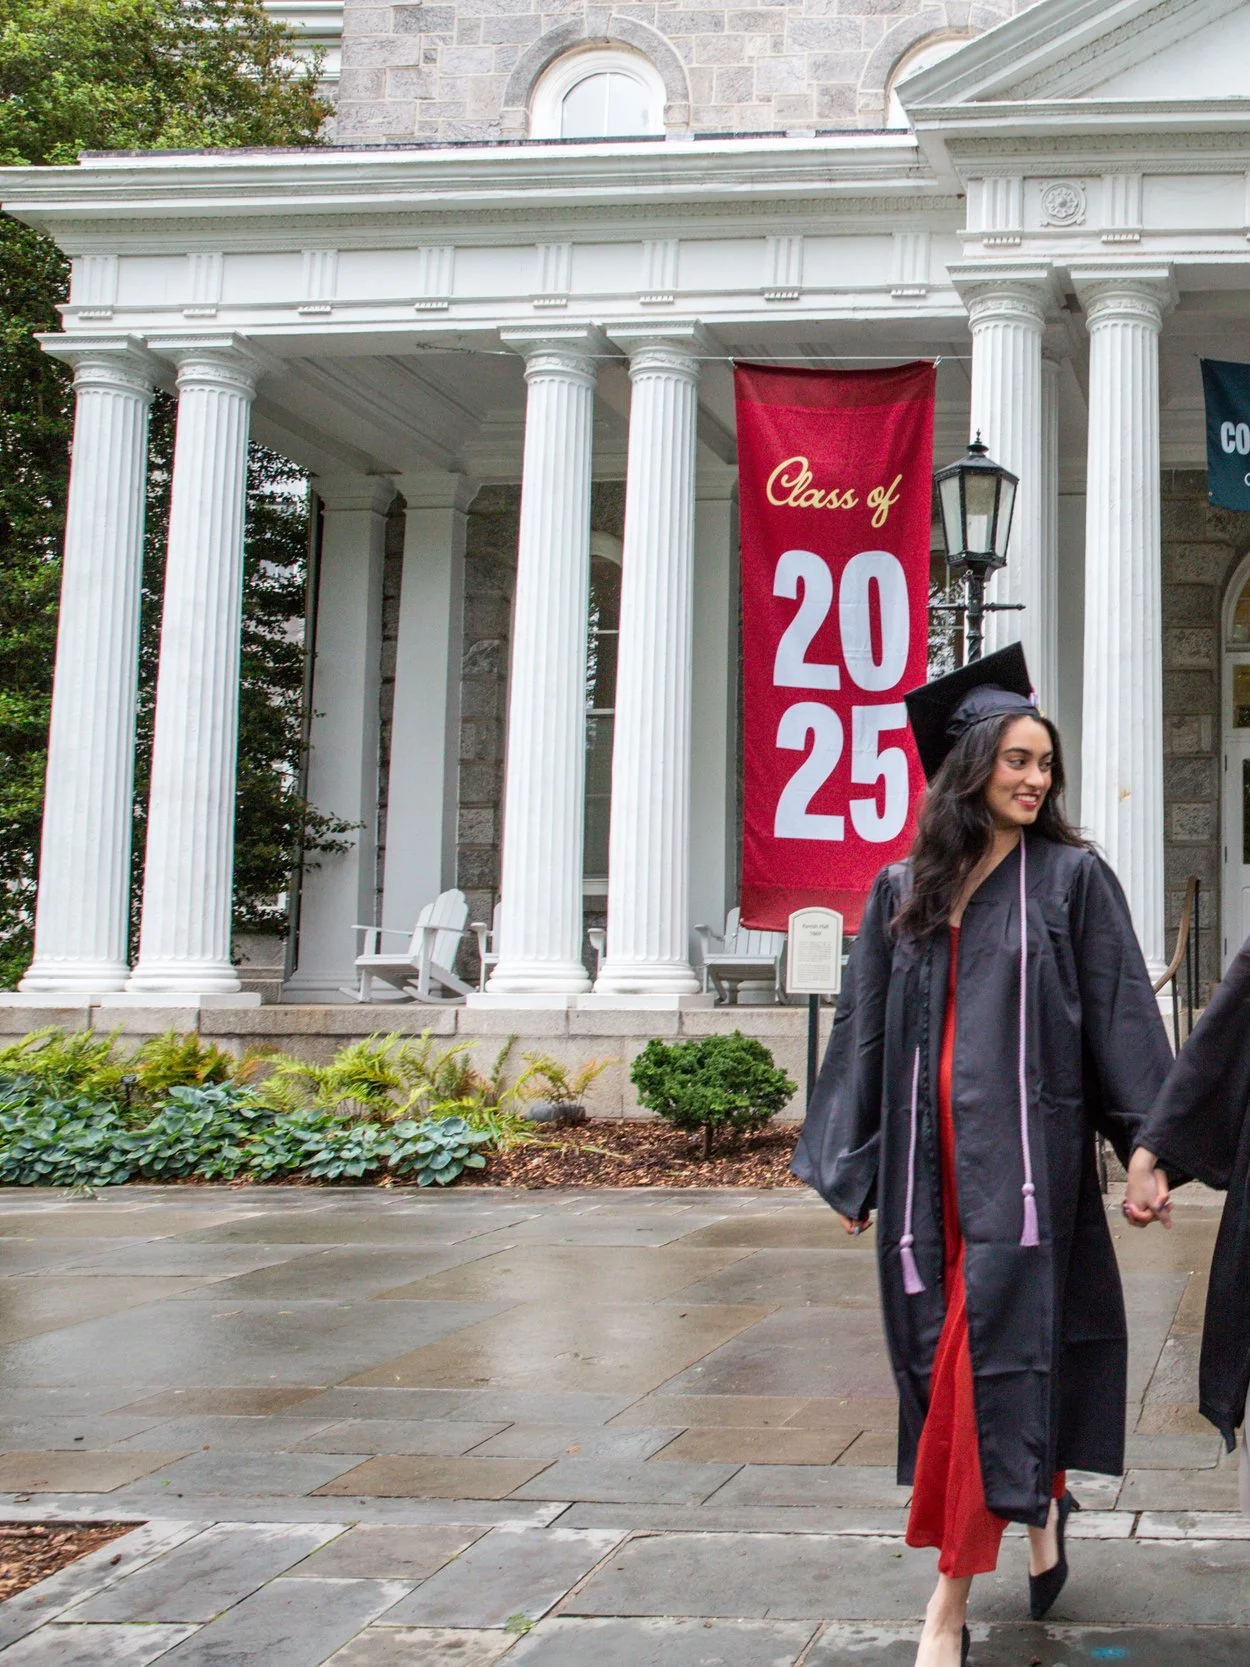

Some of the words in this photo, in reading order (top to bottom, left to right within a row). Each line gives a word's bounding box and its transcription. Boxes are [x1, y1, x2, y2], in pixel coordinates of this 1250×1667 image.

[766, 456, 859, 510] Class
[866, 473, 903, 529] of
[772, 549, 910, 692] 20
[773, 702, 909, 843] 25
